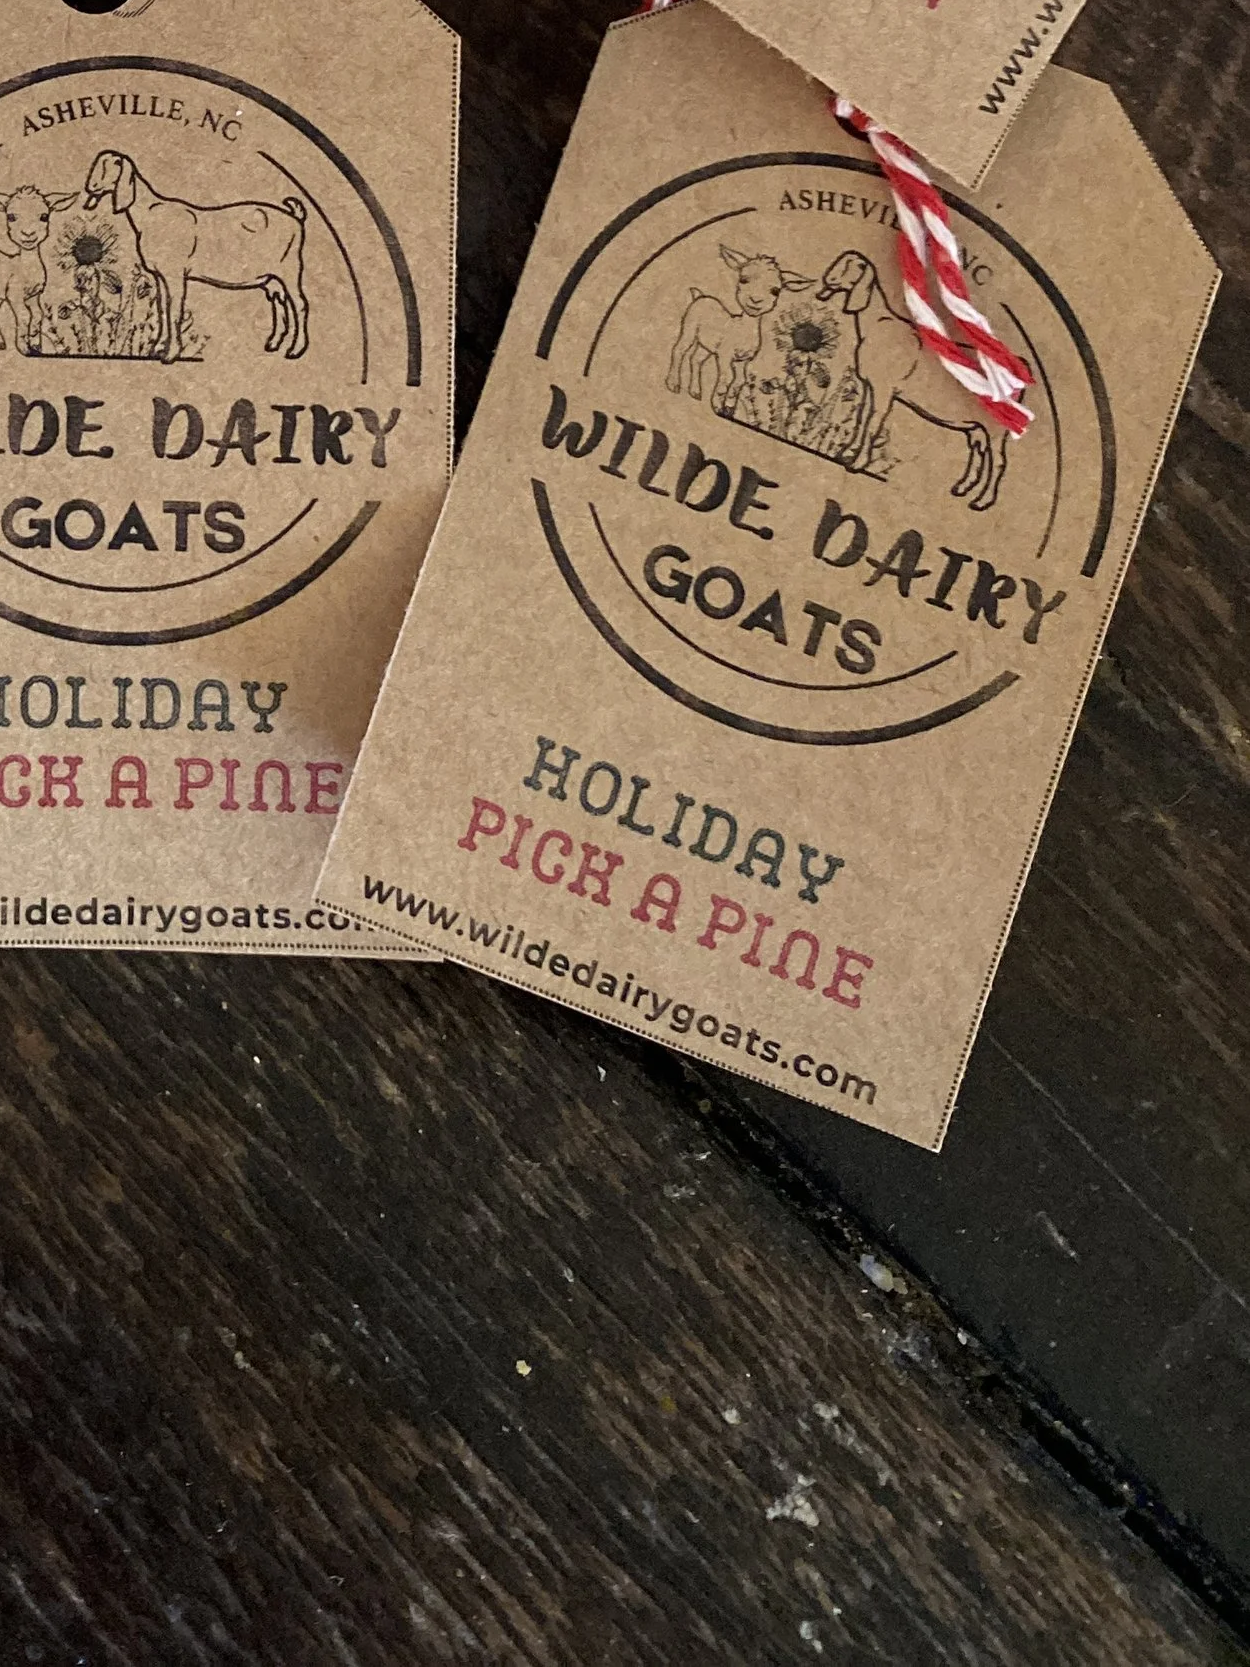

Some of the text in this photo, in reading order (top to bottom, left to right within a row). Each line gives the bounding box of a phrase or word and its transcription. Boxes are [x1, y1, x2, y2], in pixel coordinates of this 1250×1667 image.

[23, 94, 242, 142] ASHEVILLE, NC
[152, 400, 401, 468] DAIRY
[1, 497, 247, 554] GOATS
[542, 385, 1067, 646] WILDE DAIRY
[644, 543, 883, 675] GOATS
[105, 755, 150, 811] A
[173, 759, 343, 814] PINE
[524, 734, 846, 906] HOLIDAY
[457, 796, 875, 1011] PICK A PINE
[363, 874, 878, 1107] www.wildedairygoats.com
